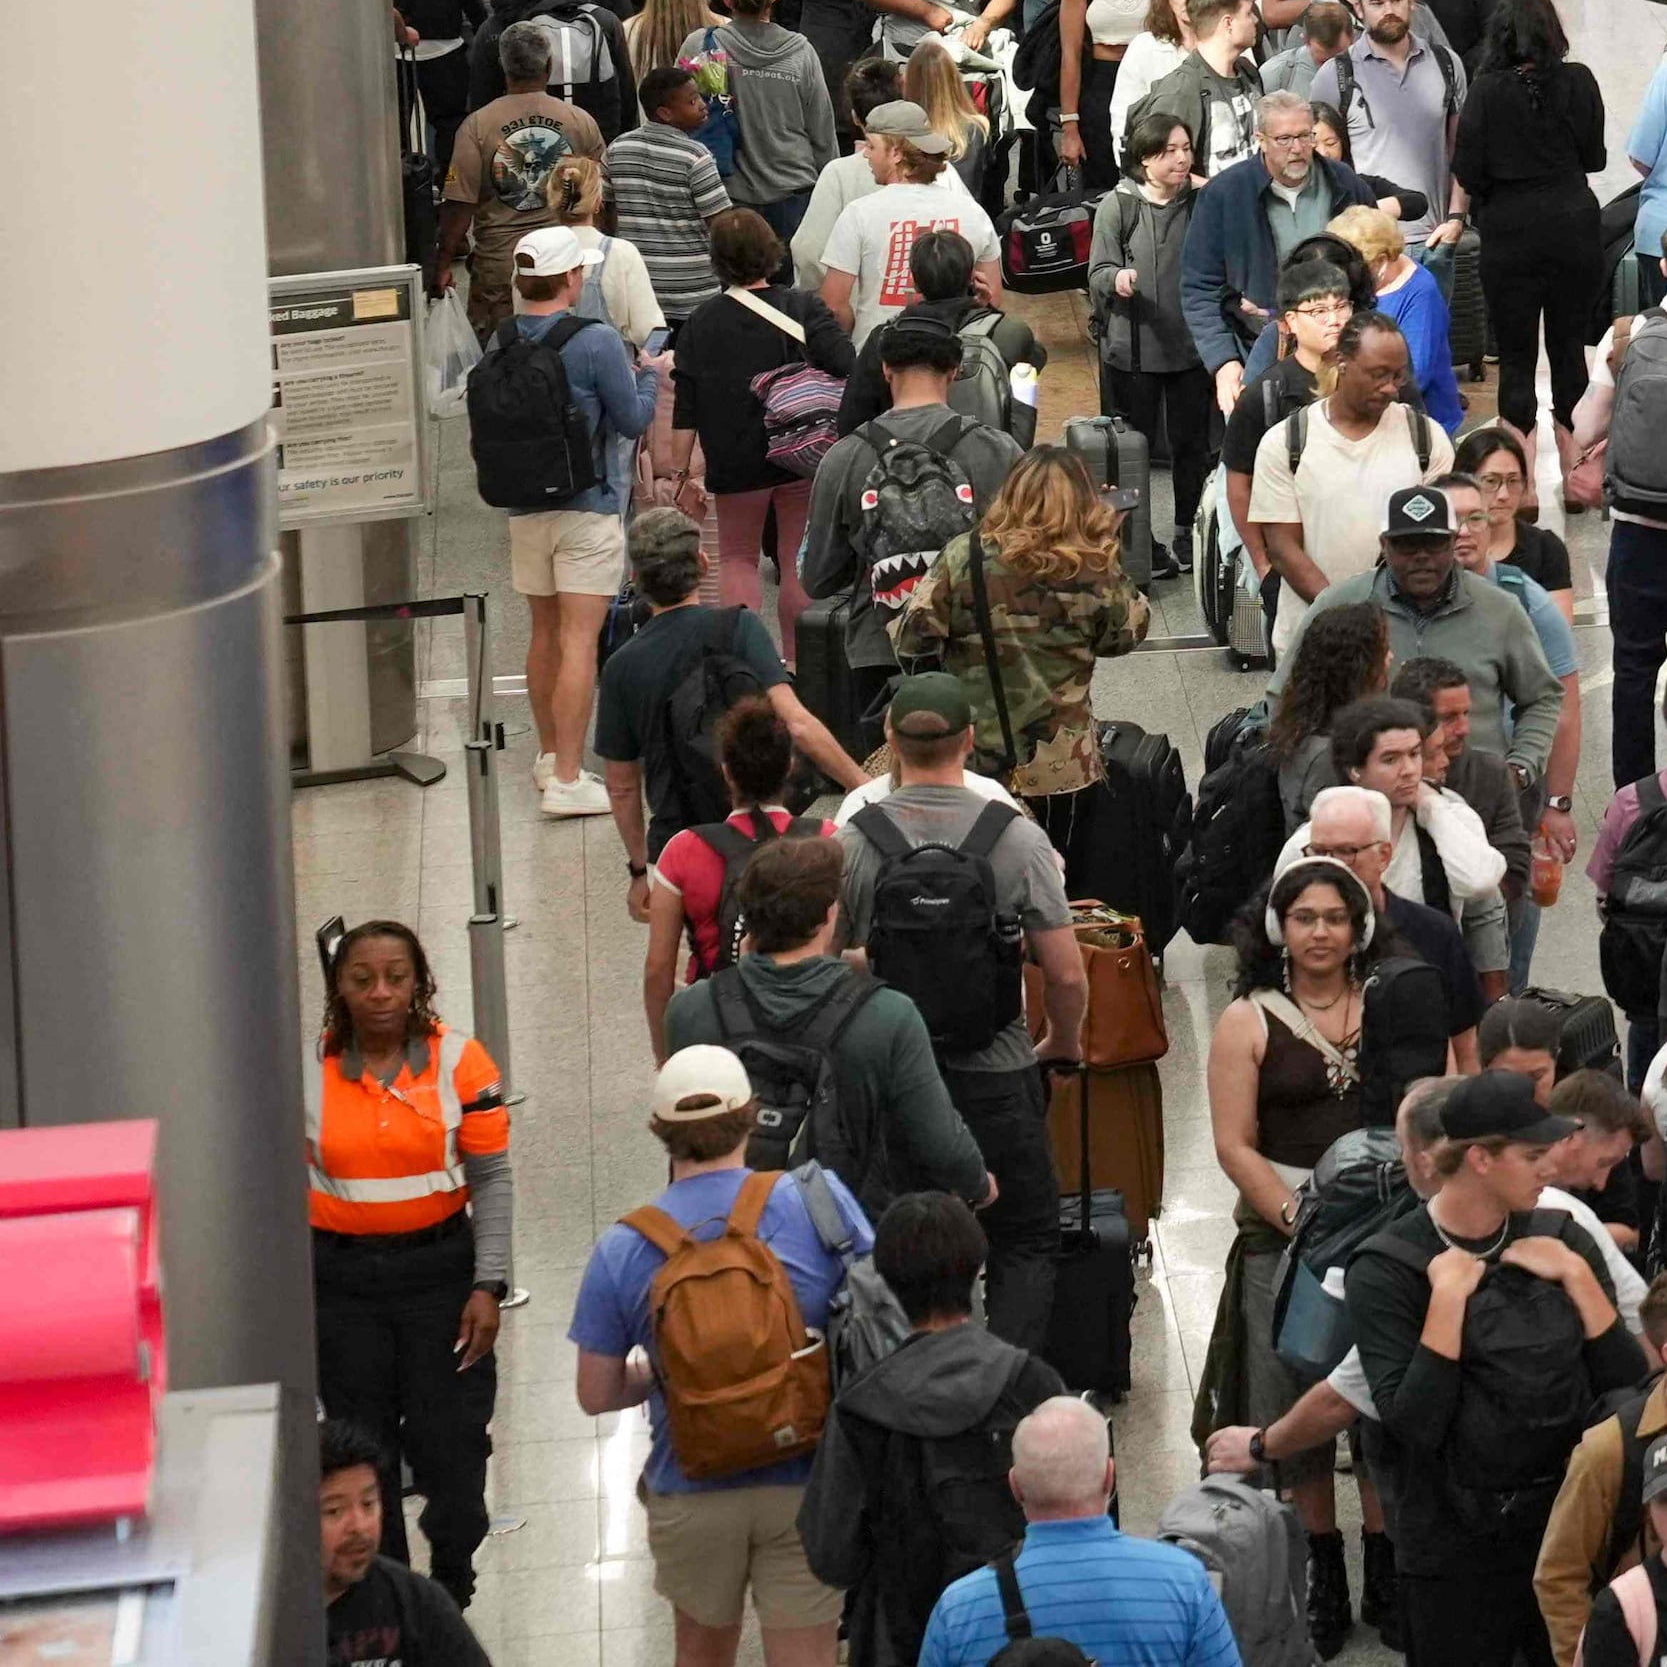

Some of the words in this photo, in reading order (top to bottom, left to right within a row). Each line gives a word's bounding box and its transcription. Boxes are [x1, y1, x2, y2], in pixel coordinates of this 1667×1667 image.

[291, 306, 338, 321] Baggage
[292, 476, 327, 494] safety
[329, 477, 339, 487] is
[341, 474, 360, 486] our
[362, 468, 404, 485] priority
